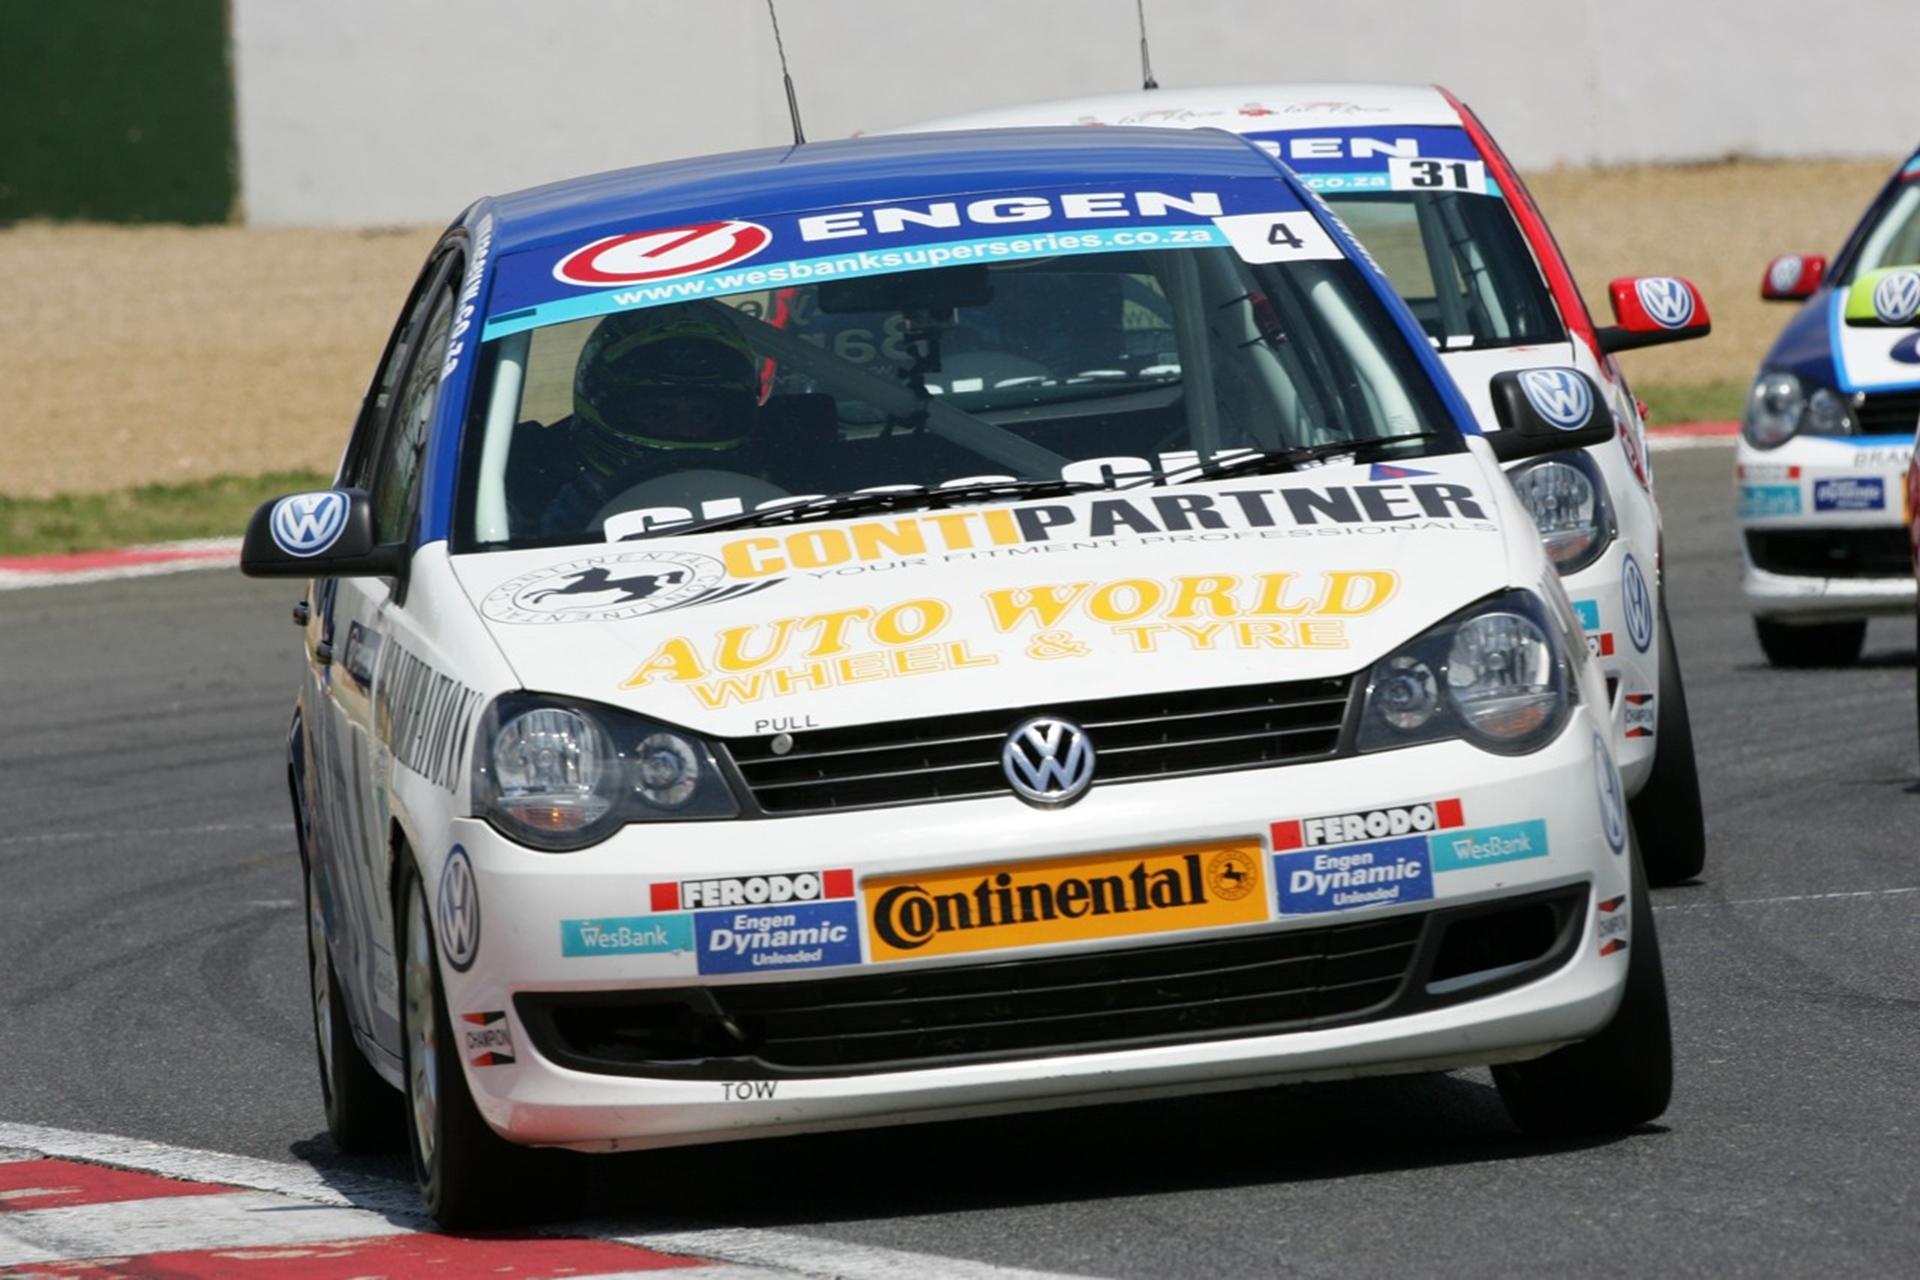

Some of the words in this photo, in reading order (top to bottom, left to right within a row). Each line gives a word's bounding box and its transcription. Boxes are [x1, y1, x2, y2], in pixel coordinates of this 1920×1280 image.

[1410, 161, 1468, 188] 31
[798, 191, 1224, 243] ENGEN
[1267, 223, 1304, 249] 4
[612, 227, 1212, 307] www.wesbanksuperseries.co.za
[808, 557, 928, 580] YOUR
[943, 538, 1120, 563] FITMENT
[1141, 521, 1498, 546] PROFESSIONALS
[618, 597, 951, 690] AUTO
[982, 569, 1399, 635] WORLD
[685, 641, 998, 711] WHEEL
[1025, 630, 1092, 660] &
[1113, 620, 1351, 655] TYRE
[755, 715, 819, 734] PULL
[1304, 804, 1436, 845] FERODO
[1314, 852, 1374, 871] Engen
[1452, 833, 1532, 861] WesBank
[682, 871, 821, 909] FERODO
[1289, 858, 1421, 895] Dynamic
[873, 854, 1208, 949] Continental
[1333, 886, 1399, 906] Unleaded
[580, 925, 668, 949] WesBank
[734, 914, 796, 931] Engen
[709, 921, 848, 957] Dynamic
[752, 948, 822, 966] Unleaded
[721, 1081, 778, 1101] TOW
